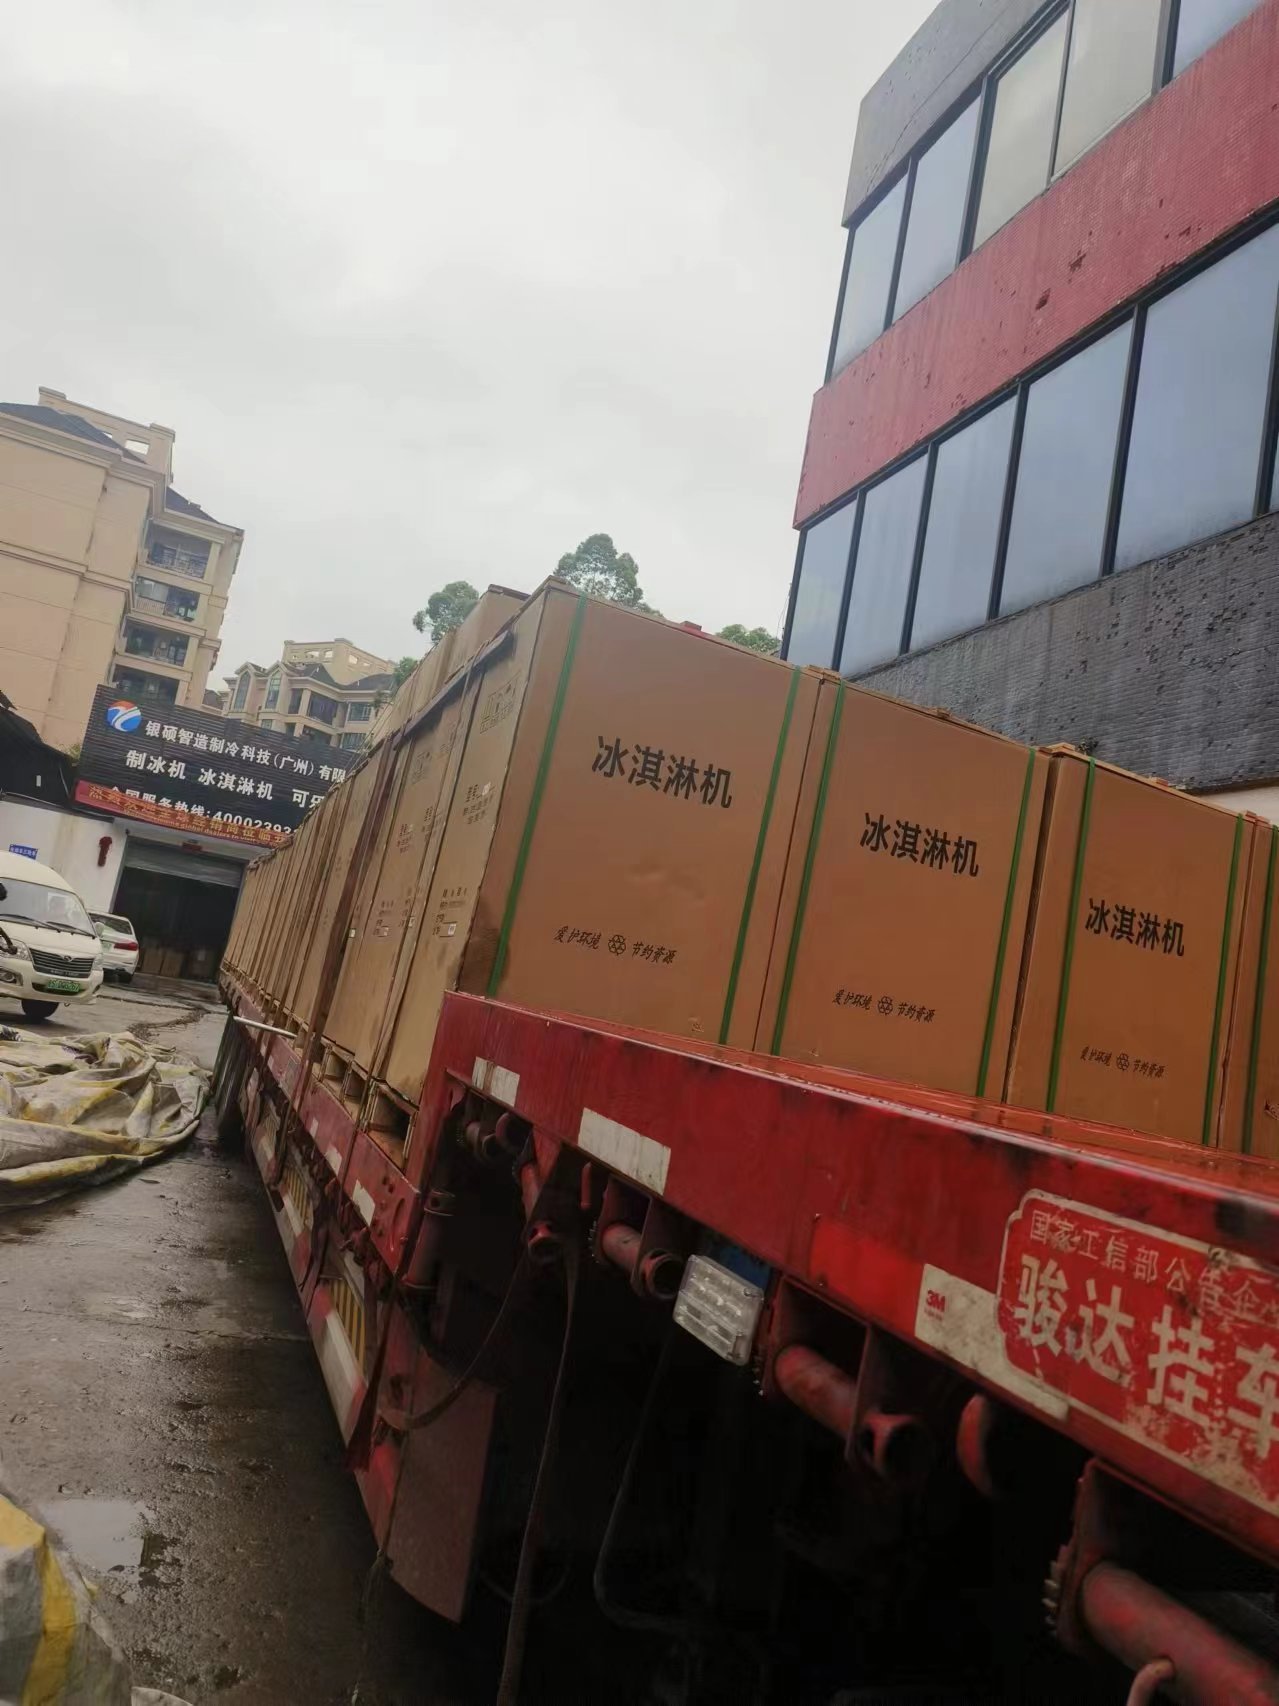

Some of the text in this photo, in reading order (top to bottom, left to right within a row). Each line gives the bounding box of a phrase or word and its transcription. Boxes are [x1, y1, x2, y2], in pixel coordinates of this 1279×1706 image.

[125, 750, 186, 780] 制冰机
[198, 768, 273, 800] 冰淇淋机
[592, 736, 732, 808] 冰淇淋机
[860, 813, 979, 877] 冰淇淋机
[554, 926, 677, 964] 爱护环境 节约资源
[1085, 898, 1184, 956] 冰淇淋机
[897, 1003, 935, 1023] 节约资源
